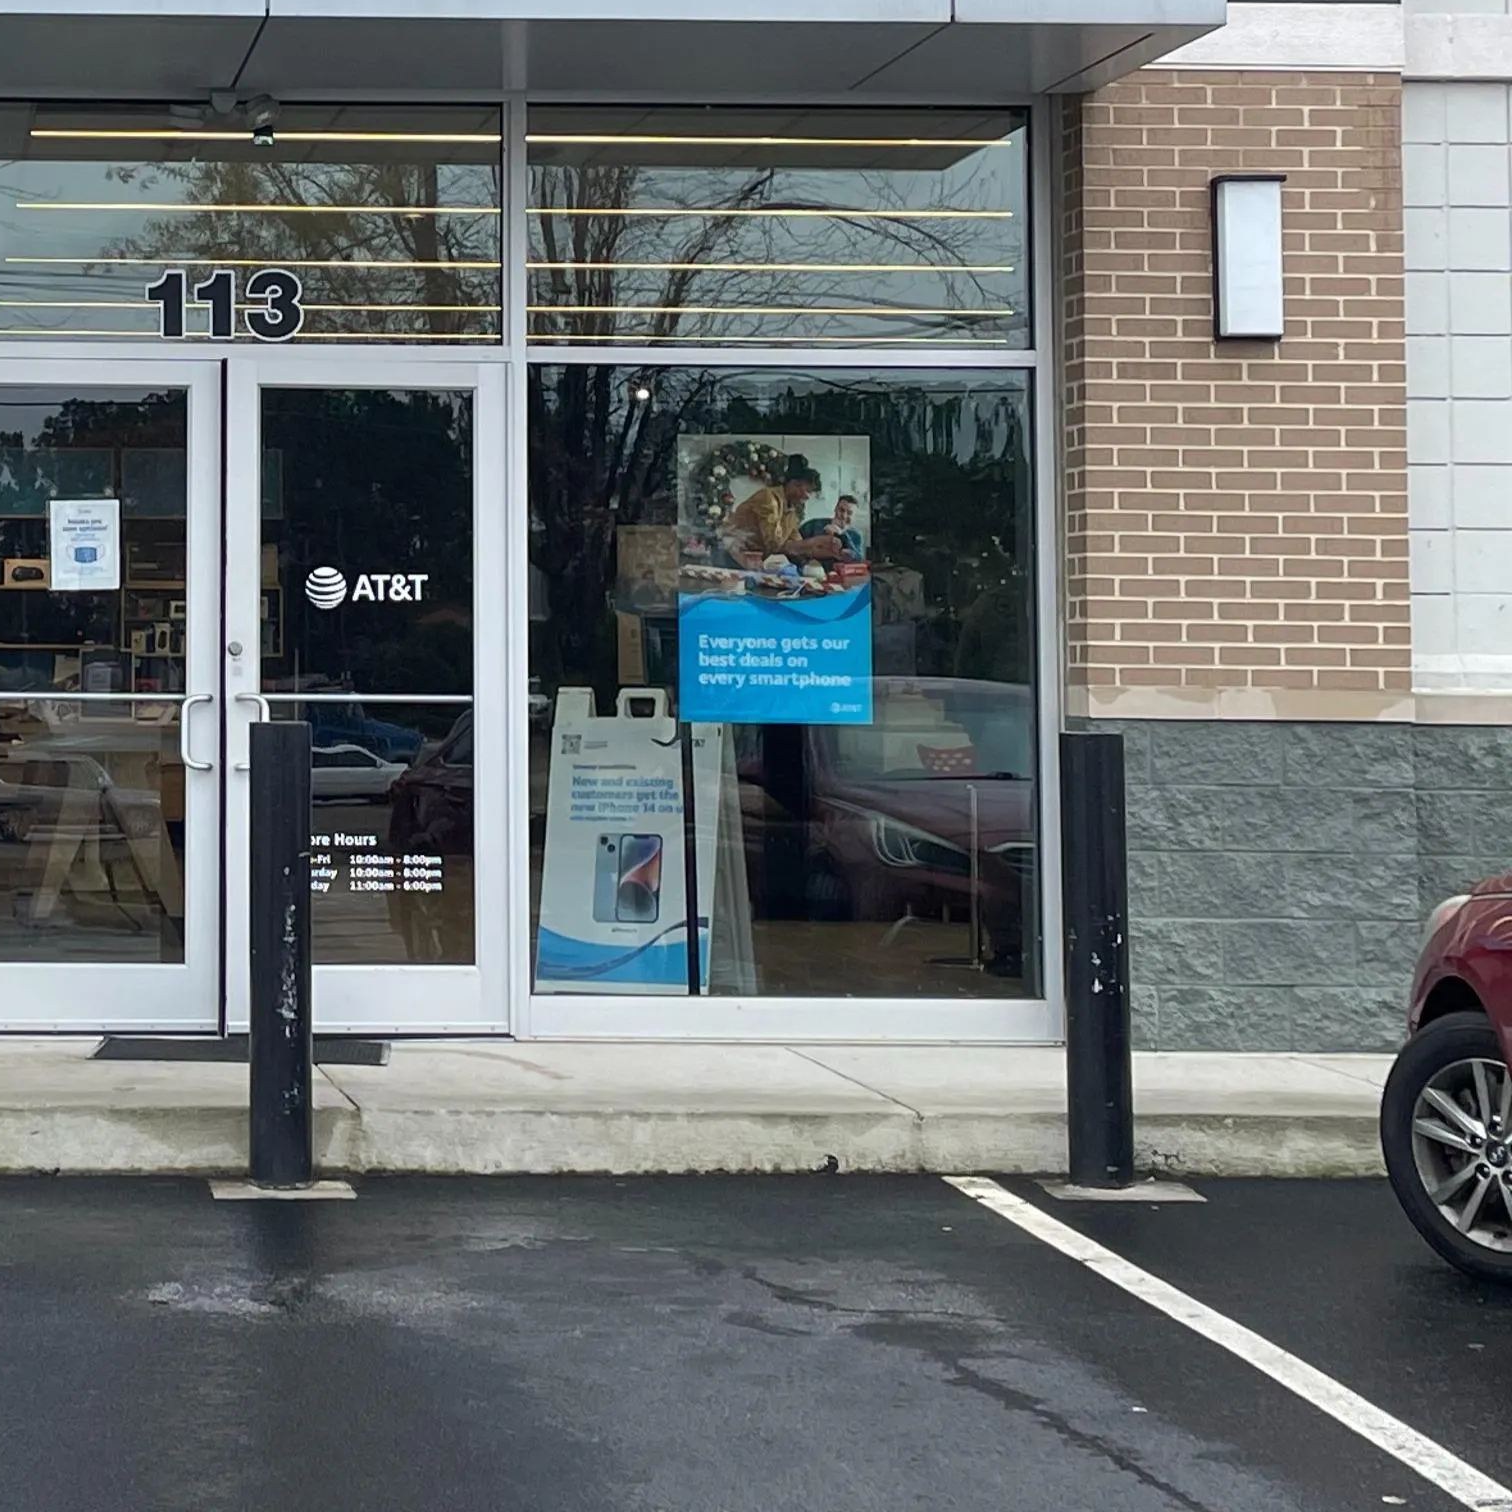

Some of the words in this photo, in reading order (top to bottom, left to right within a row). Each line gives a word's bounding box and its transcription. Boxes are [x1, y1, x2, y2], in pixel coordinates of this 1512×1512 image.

[145, 268, 304, 342] 113
[352, 574, 428, 601] AT&T
[699, 635, 777, 652] Everyone
[781, 637, 817, 652] gets
[822, 639, 850, 649] our
[699, 652, 736, 666] best
[740, 653, 783, 667] deals
[787, 657, 808, 667] on
[699, 673, 745, 688] every
[749, 672, 852, 689] smartphone
[572, 776, 598, 787] New
[601, 776, 623, 786] and
[626, 776, 673, 789] existing
[571, 790, 633, 800] customers
[637, 791, 657, 801] get
[659, 789, 679, 800] the
[570, 804, 595, 812] new
[598, 802, 638, 813] iPhone
[334, 833, 377, 846] Hours
[350, 855, 394, 864] 10:00am
[403, 855, 442, 866] 8:00pm
[350, 868, 394, 877] 10:00am
[350, 881, 394, 890] 11:00am
[403, 881, 442, 893] 6:00pm
